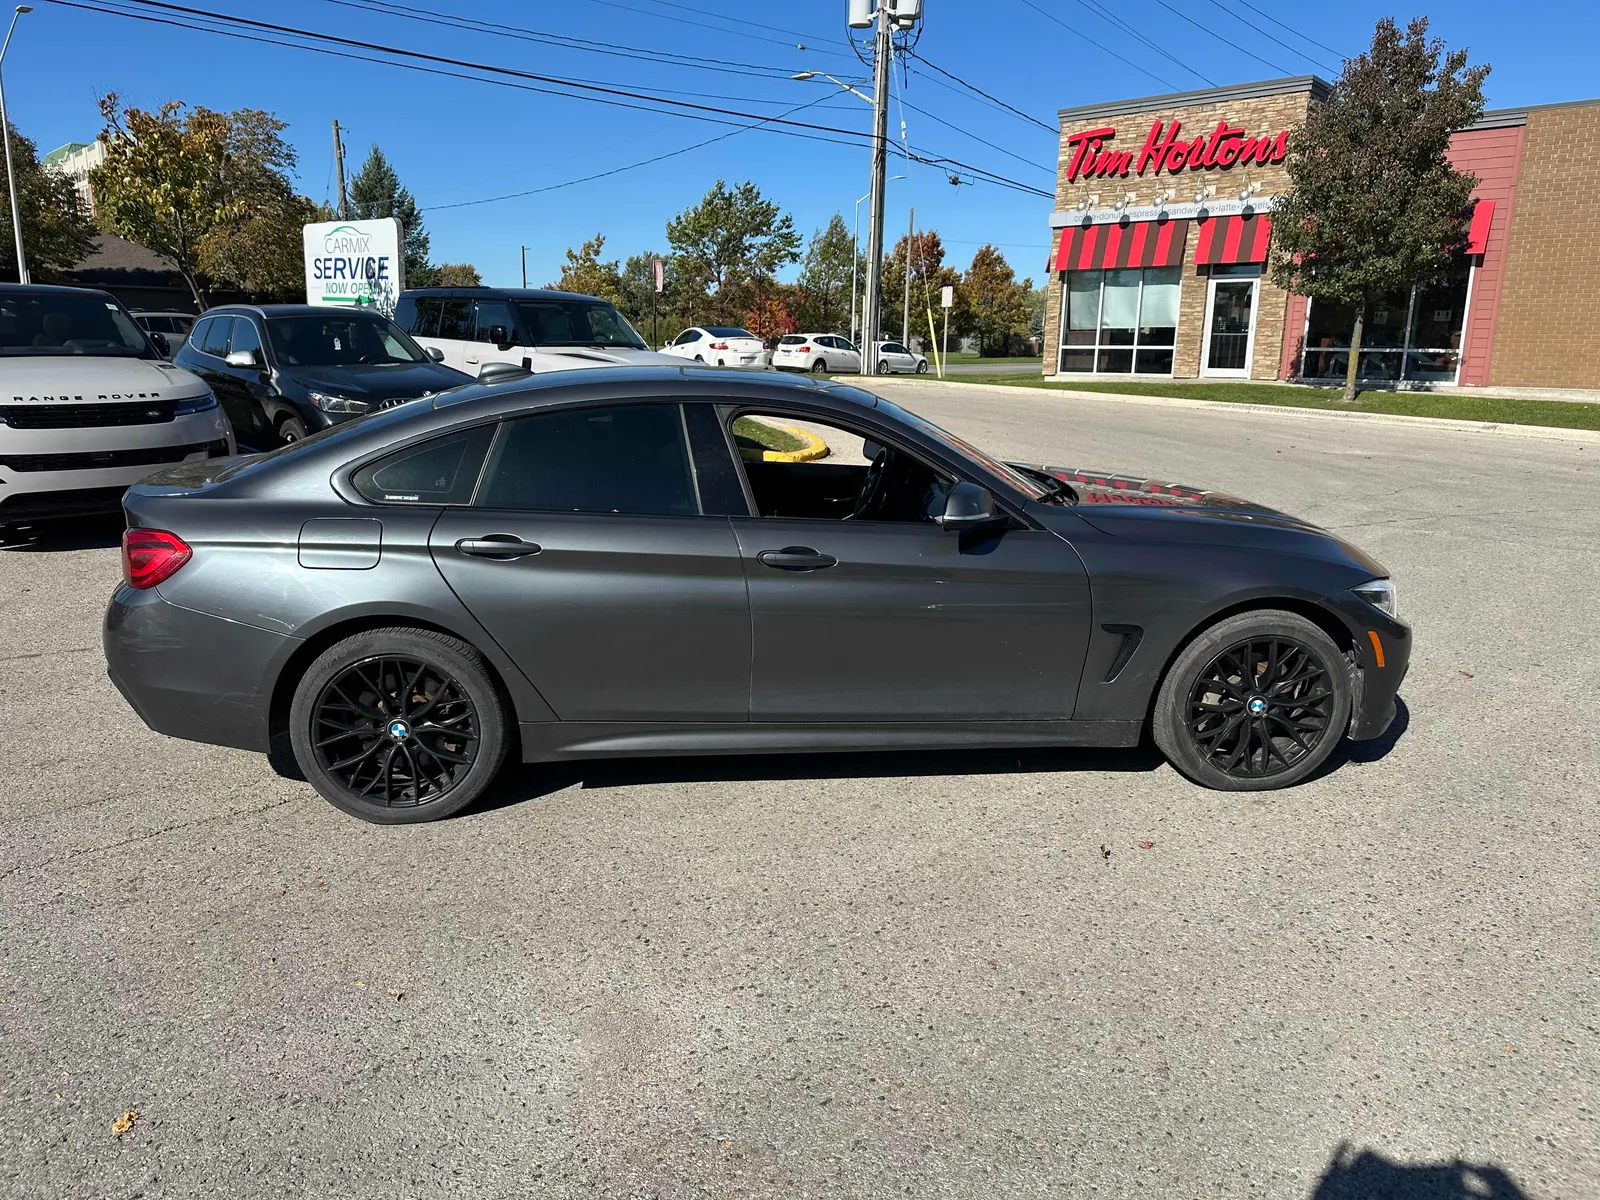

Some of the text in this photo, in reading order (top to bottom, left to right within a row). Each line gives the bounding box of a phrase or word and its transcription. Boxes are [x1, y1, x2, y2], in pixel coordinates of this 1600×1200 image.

[1066, 119, 1288, 181] Tim Hortons
[1219, 202, 1236, 212] latte
[325, 236, 370, 254] CARMIX
[313, 256, 389, 280] SERVICE
[325, 282, 348, 294] NOW
[98, 392, 160, 400] ROVER
